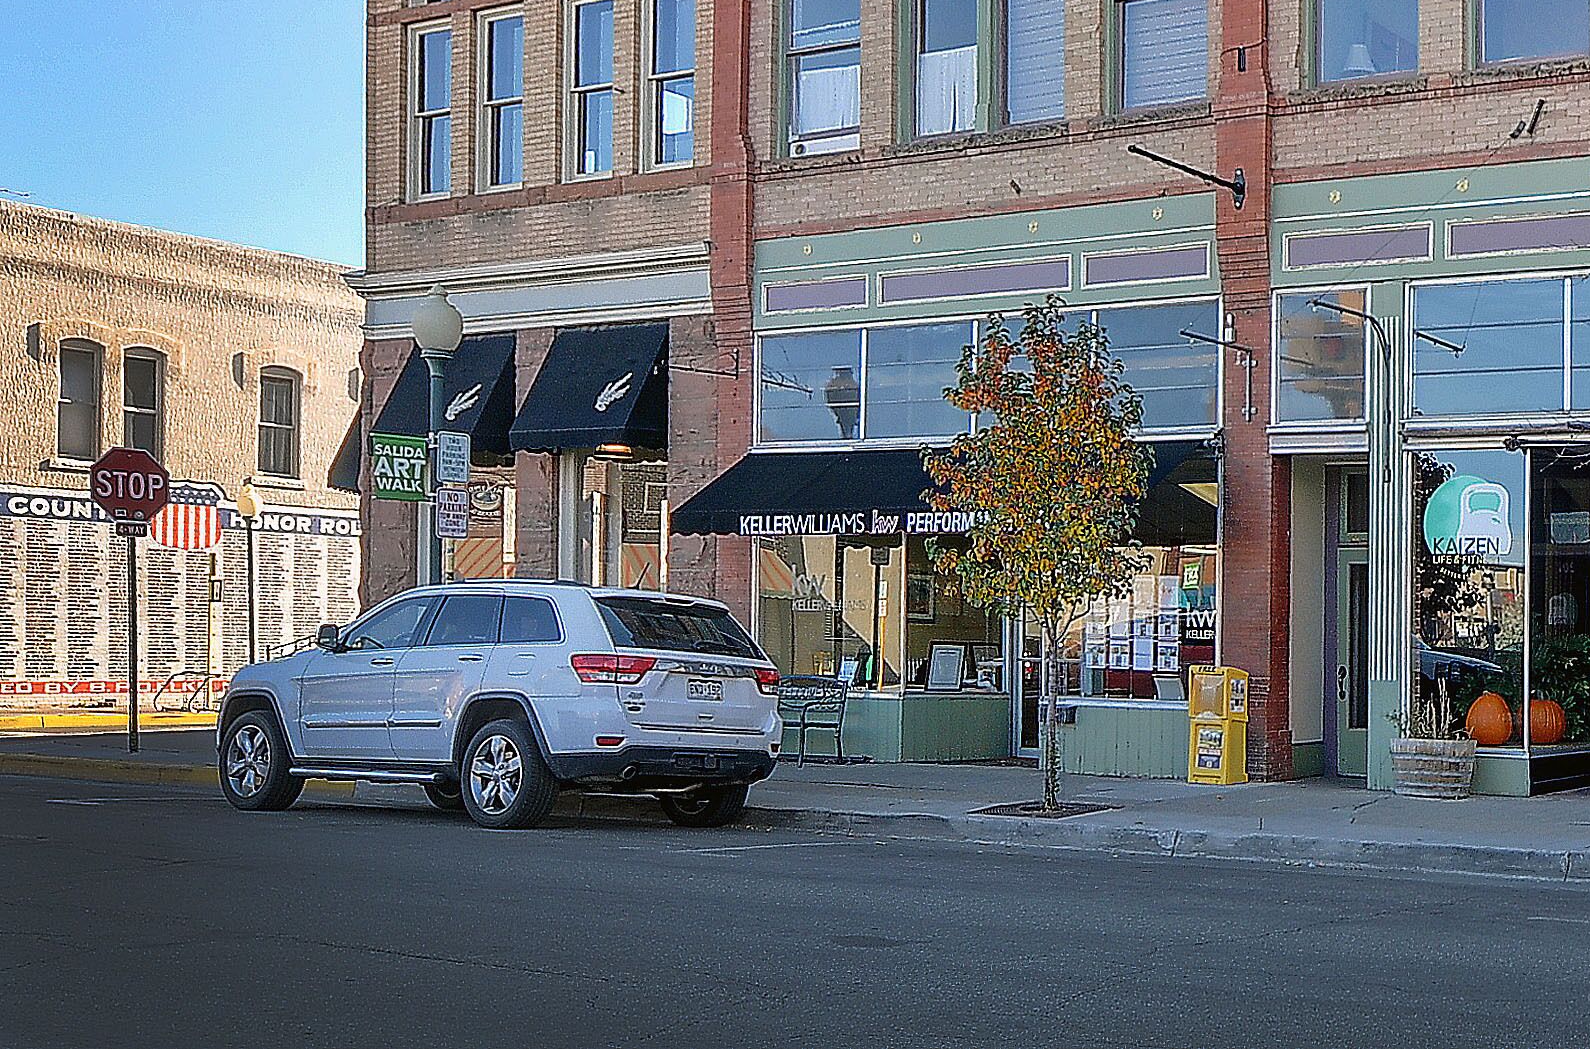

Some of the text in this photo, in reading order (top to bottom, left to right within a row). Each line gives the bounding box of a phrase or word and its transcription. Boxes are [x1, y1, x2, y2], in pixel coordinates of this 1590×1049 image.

[374, 443, 425, 458] SALIDA
[374, 456, 426, 479] ART
[96, 470, 164, 500] STOP
[376, 477, 423, 492] WALK
[447, 493, 460, 502] NO
[7, 496, 107, 519] COUNT
[118, 526, 146, 536] 4-WAY
[1433, 537, 1500, 554] KAIZEN
[1432, 554, 1453, 565] LIFE
[44, 682, 78, 694] BY
